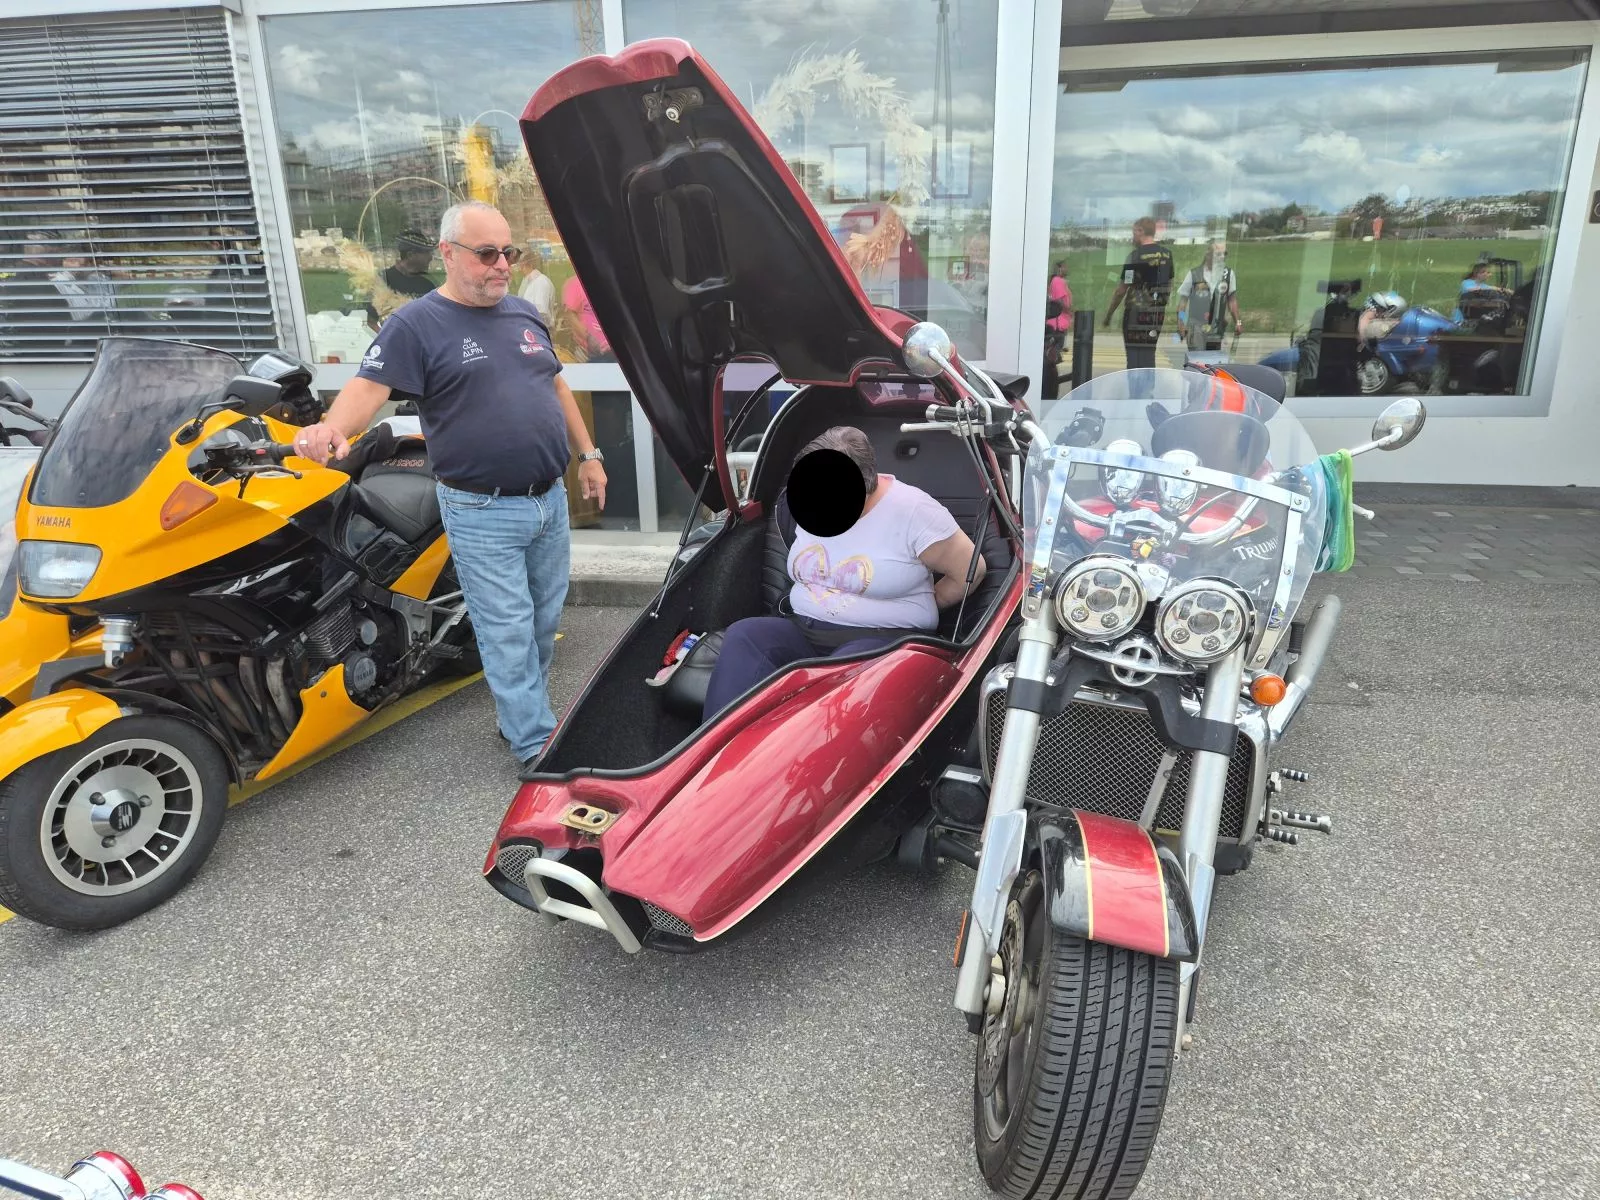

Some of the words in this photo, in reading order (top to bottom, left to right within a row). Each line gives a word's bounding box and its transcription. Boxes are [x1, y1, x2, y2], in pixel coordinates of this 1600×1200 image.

[462, 341, 478, 350] CLUB
[463, 347, 484, 358] ALPIN
[36, 516, 71, 528] YAMAHA
